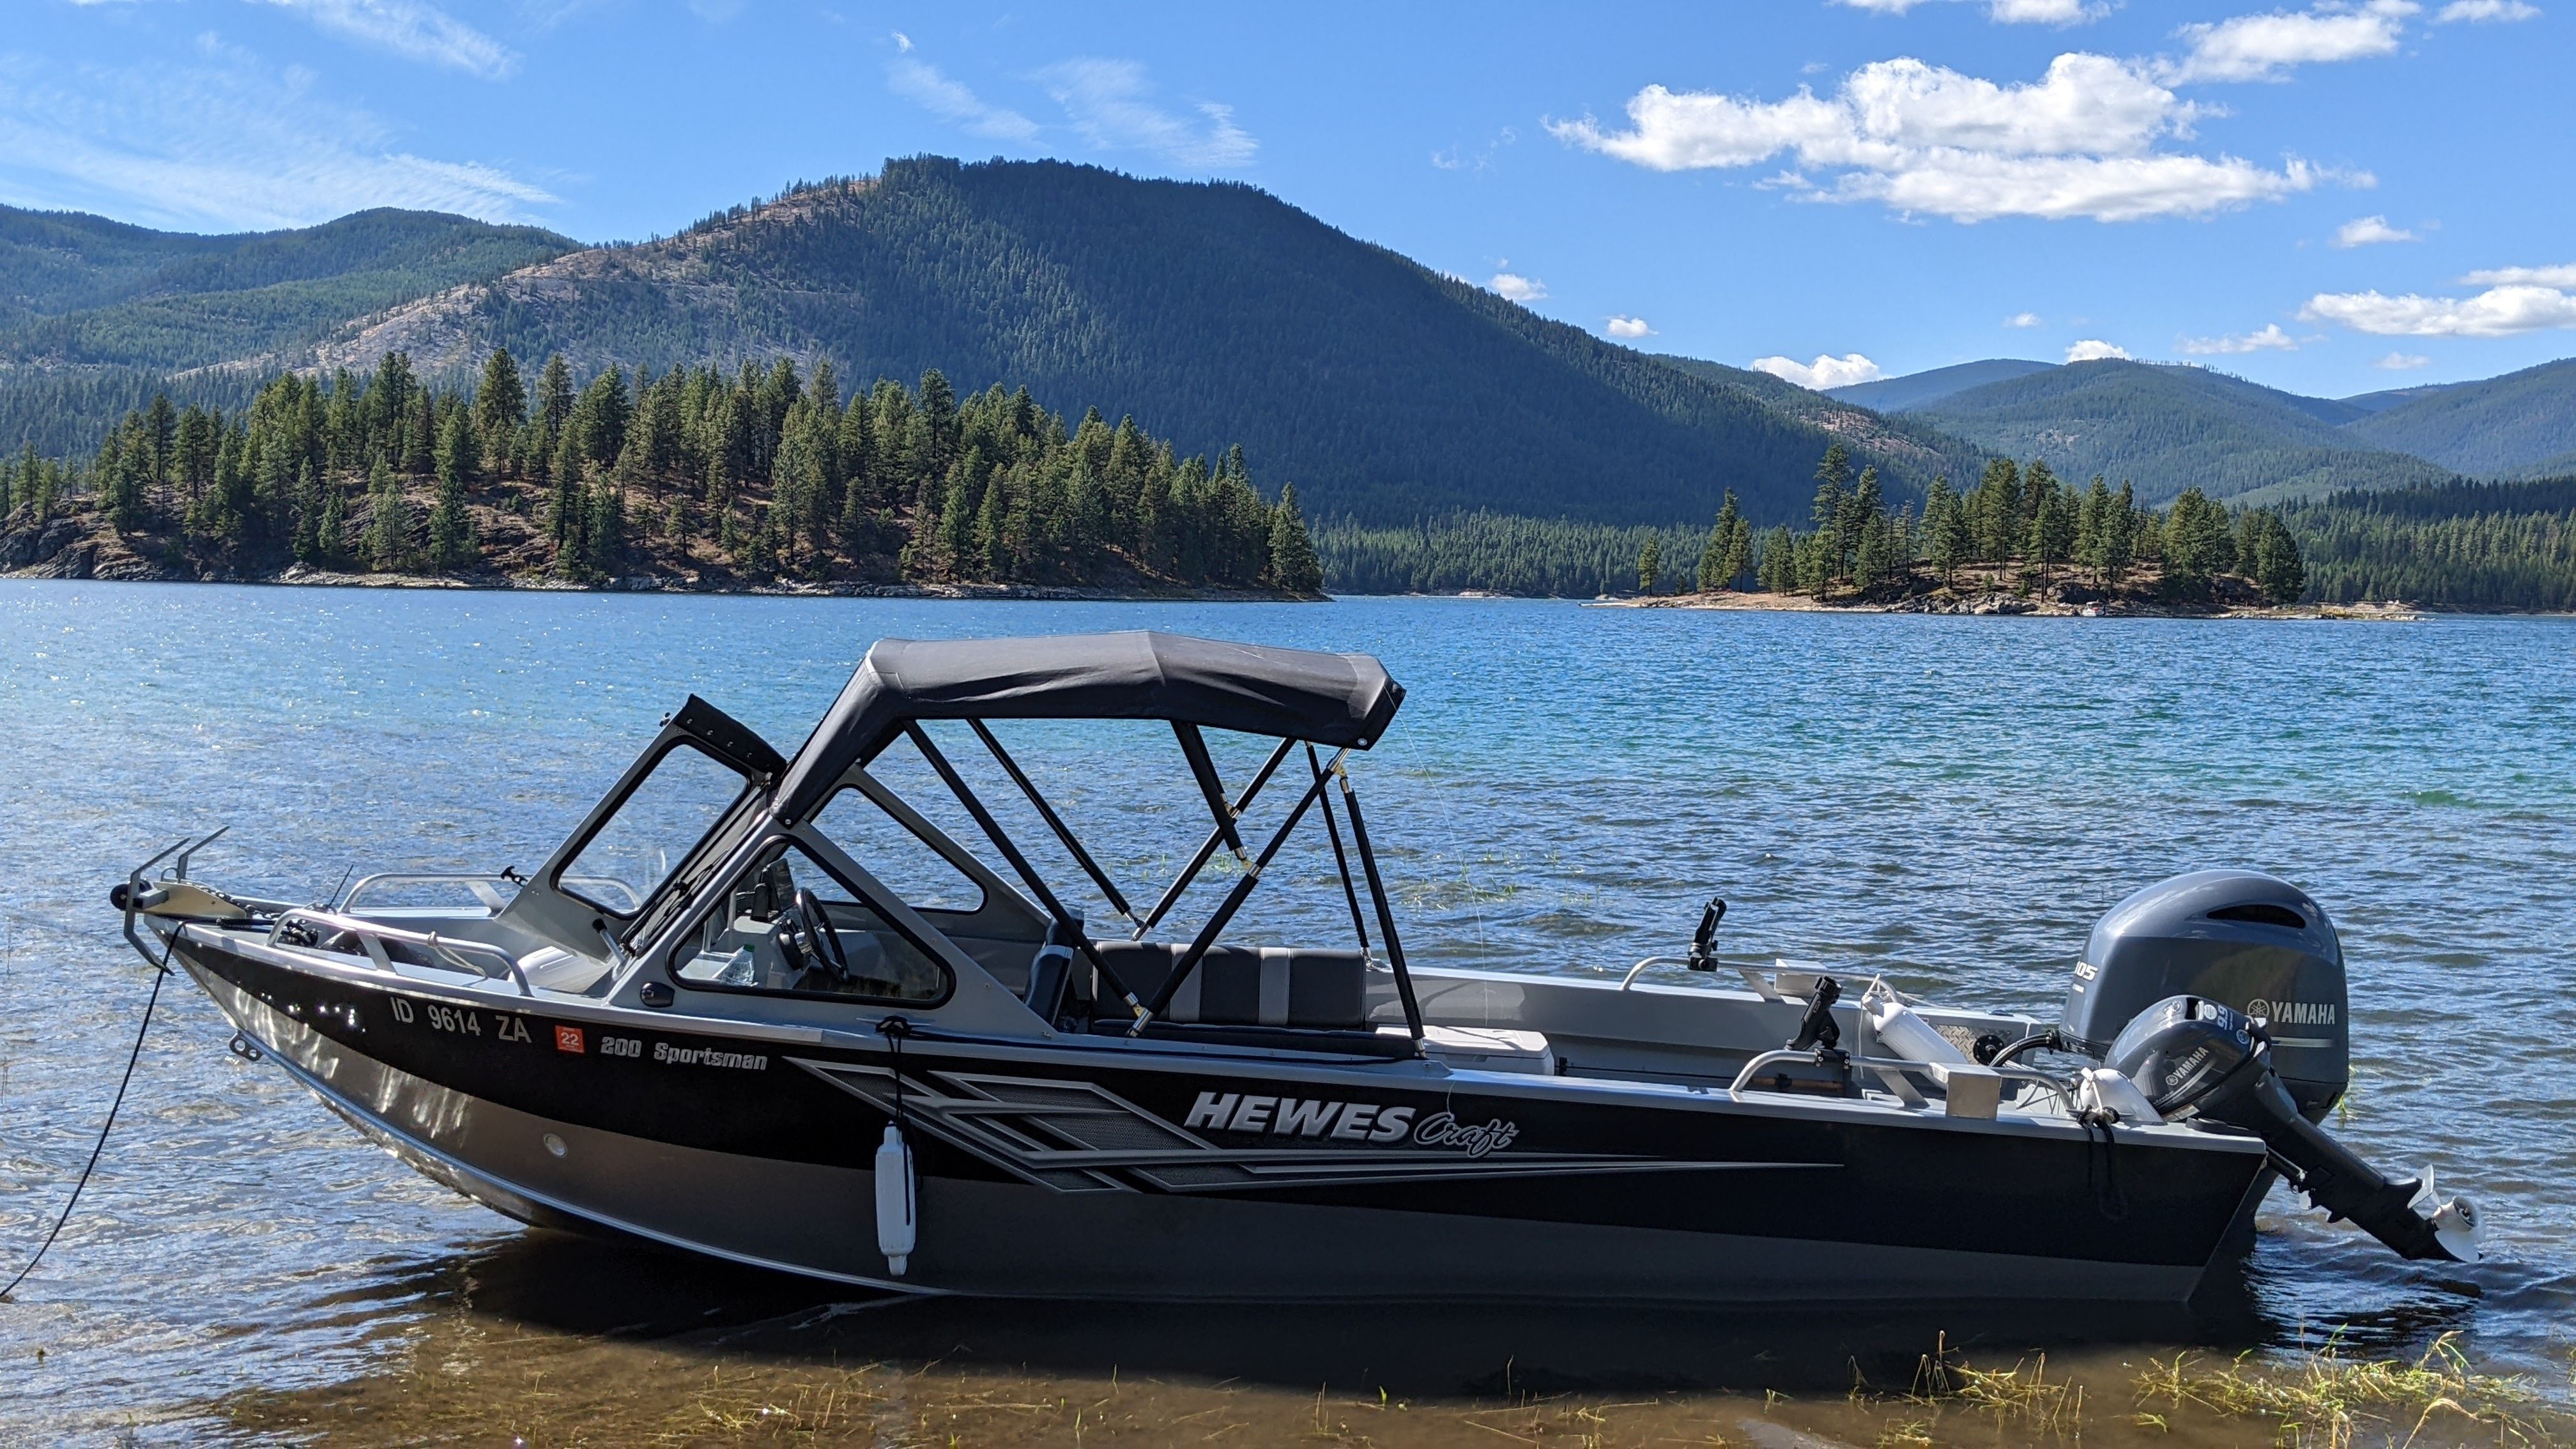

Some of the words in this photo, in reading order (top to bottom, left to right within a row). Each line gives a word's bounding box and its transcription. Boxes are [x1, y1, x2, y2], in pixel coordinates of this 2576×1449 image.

[390, 996, 414, 1023] ID
[427, 1004, 481, 1036] 9614
[495, 1015, 532, 1043] ZA
[2272, 1000, 2336, 1025] YAMAHA
[561, 1032, 579, 1045] 22
[600, 1036, 642, 1058] 200
[654, 1042, 768, 1070] Sportsman
[2173, 1046, 2209, 1079] YAMAHA
[1183, 1091, 1416, 1142] HEWES
[1413, 1111, 1521, 1158] Craft
